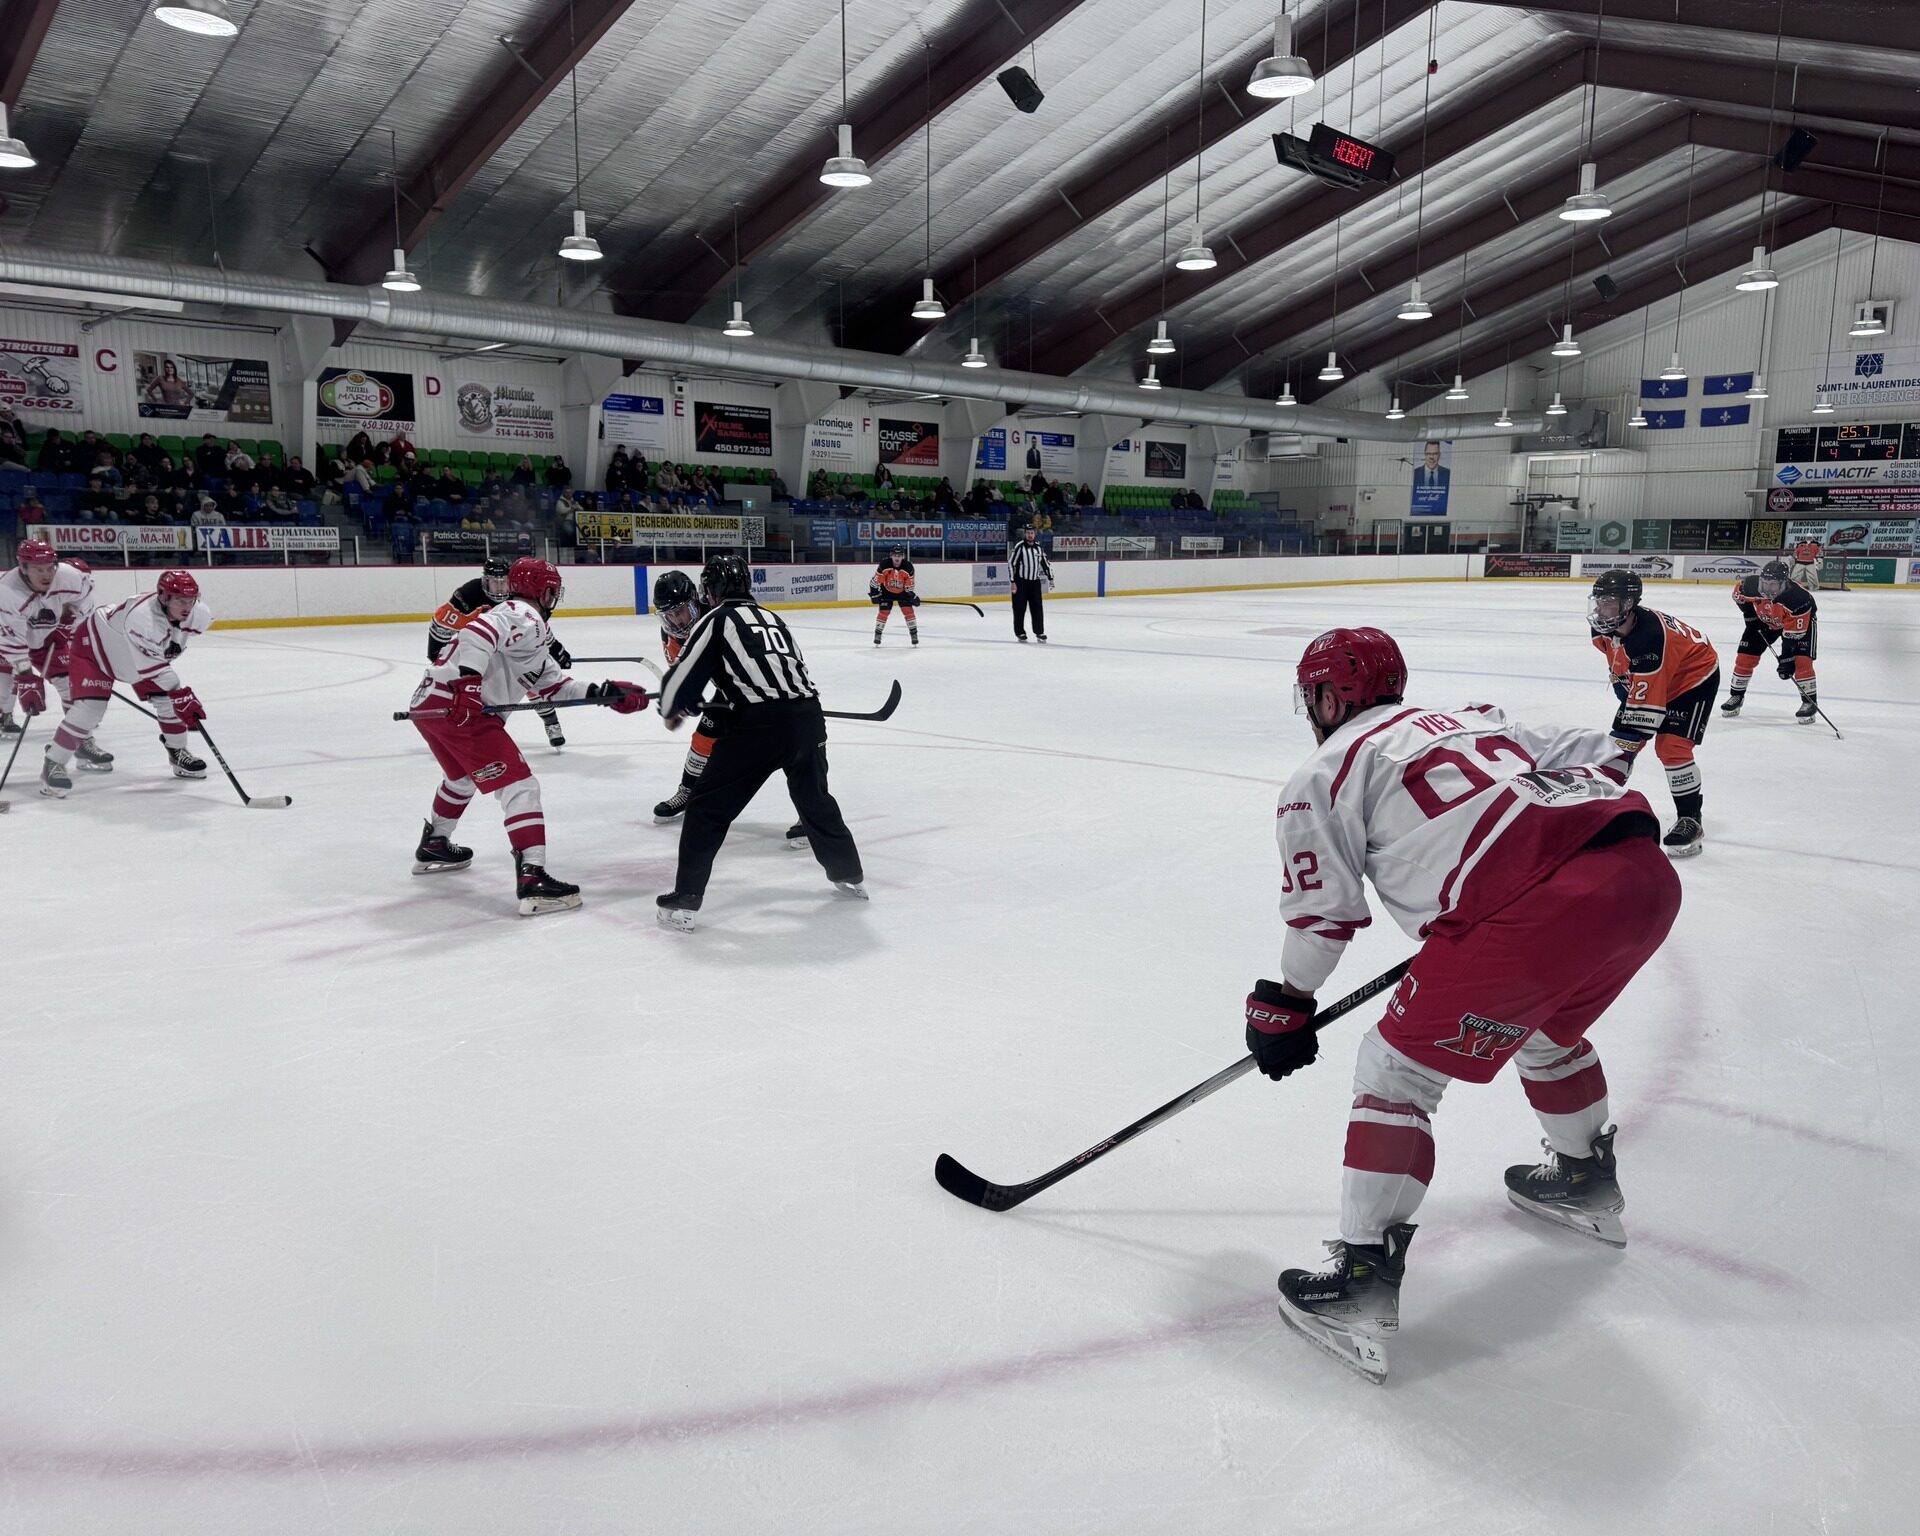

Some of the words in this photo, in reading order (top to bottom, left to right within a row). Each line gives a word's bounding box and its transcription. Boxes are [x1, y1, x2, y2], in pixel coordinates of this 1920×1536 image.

[1333, 137, 1375, 171] HEBERT
[96, 349, 117, 372] C
[232, 376, 268, 384] DUQUETTE
[426, 376, 441, 395] D
[346, 386, 369, 394] PIZZERIA
[337, 393, 379, 402] MARIO
[675, 400, 684, 417] E
[863, 418, 871, 432] F
[495, 428, 510, 436] 514
[514, 429, 554, 439] 444-3018
[880, 430, 919, 442] CHASSE
[1012, 430, 1020, 444] G
[1841, 426, 1871, 438] 25.7
[715, 444, 770, 455] 450.917.3939
[1134, 441, 1141, 453] H
[1886, 446, 1895, 458] 2
[1830, 449, 1838, 458] 4
[1805, 467, 1878, 479] CLIMACTIF
[1883, 471, 1899, 480] 438
[1901, 470, 1920, 479] 838-
[635, 516, 692, 528] RECHERCHONS
[693, 517, 739, 529] CHAUFFEURS
[947, 523, 979, 531] LIVRAISON
[55, 528, 117, 543] MICRO
[271, 528, 337, 537] CLIMATISATION
[433, 531, 459, 539] Patrick
[875, 523, 906, 538] Jean
[907, 524, 942, 538] Coutu
[140, 533, 175, 544] MA-MI
[1826, 562, 1875, 570] Deardins
[791, 573, 834, 584] ENCOURAGEONS
[791, 585, 813, 595] L'ESPRIT
[813, 583, 835, 592] SPORTIF
[441, 610, 458, 625] 19
[1796, 618, 1804, 629] 8
[750, 626, 790, 654] 70
[1309, 667, 1330, 678] CCM
[1545, 782, 1586, 804] PAVAGE
[1328, 974, 1388, 1016] BAUER
[1303, 1291, 1340, 1300] BAUER
